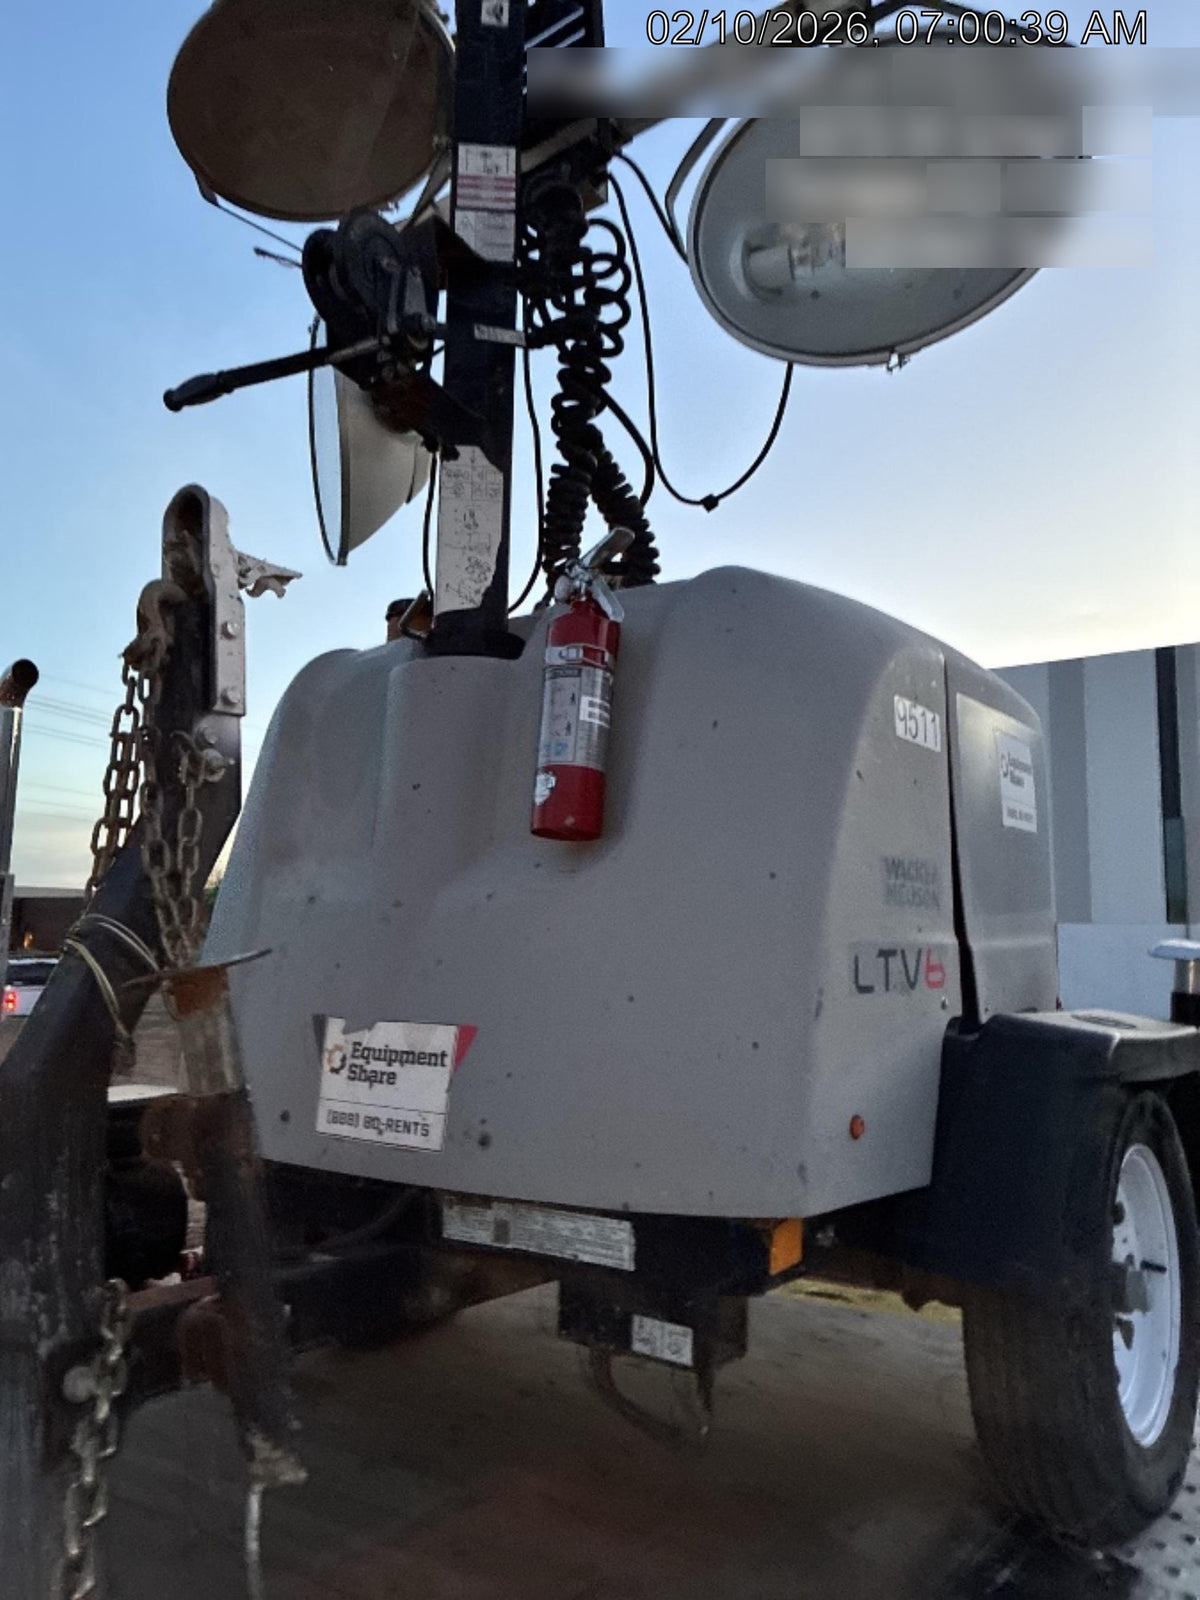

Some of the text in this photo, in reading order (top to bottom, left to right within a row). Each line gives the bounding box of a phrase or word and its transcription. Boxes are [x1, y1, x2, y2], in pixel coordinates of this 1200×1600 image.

[895, 697, 938, 747] 9511
[854, 947, 946, 994] LTV6
[351, 1041, 448, 1067] Equipment
[347, 1063, 397, 1086] Share
